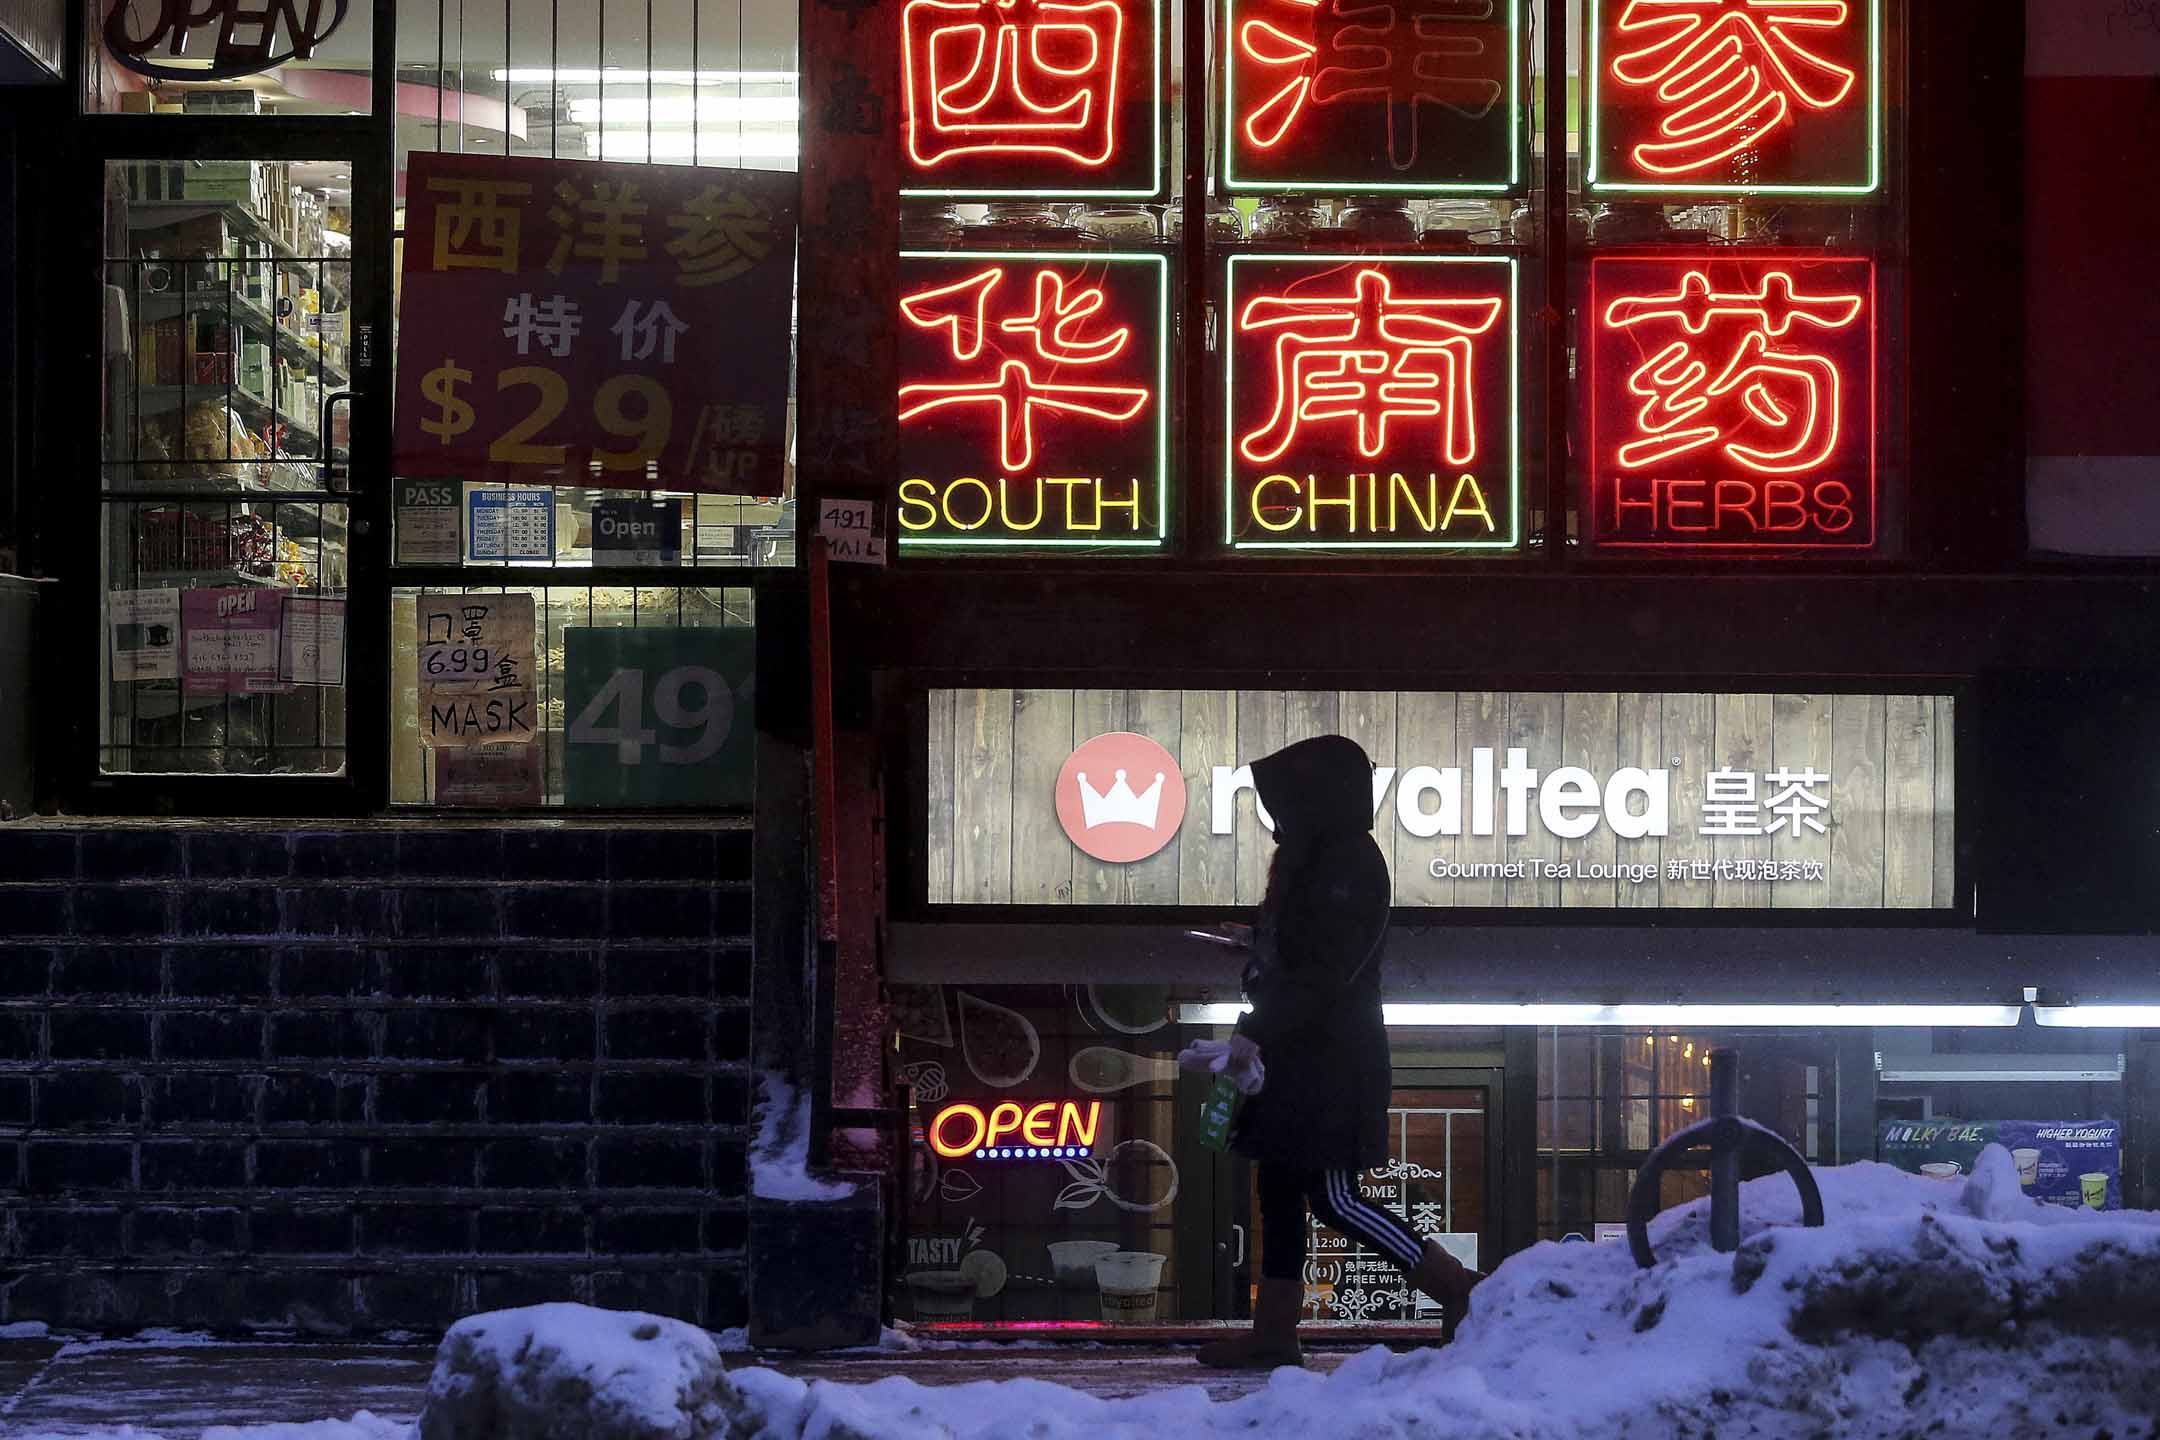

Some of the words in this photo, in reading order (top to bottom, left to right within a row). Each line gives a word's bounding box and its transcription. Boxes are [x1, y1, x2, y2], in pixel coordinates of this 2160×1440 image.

[427, 177, 773, 286] 西洋参
[503, 293, 690, 364] 特价
[405, 487, 453, 505] PASS
[517, 492, 541, 501] HOURS
[898, 477, 1141, 531] SOUTH
[1251, 474, 1496, 533] CHINA
[1614, 478, 1855, 533] HERBS
[600, 517, 655, 539] Open
[825, 508, 869, 530] 491
[217, 591, 256, 617] OPEN
[426, 605, 488, 646] 口罩
[427, 648, 488, 674] 6.99
[431, 697, 530, 736] MASK
[568, 664, 756, 766] 49
[1699, 766, 1830, 837] 皇茶
[1429, 858, 1526, 878] Gourmet
[1528, 859, 1572, 878] Tea
[1576, 859, 1658, 883] Lounge
[1667, 858, 1824, 881] 新世代现泡茶饮
[930, 1100, 1101, 1157] OPEN
[2036, 1128, 2073, 1139] HIGHER
[2075, 1128, 2115, 1140] YOGURT
[908, 1239, 962, 1265] TASTY
[1346, 1275, 1377, 1284] FREE
